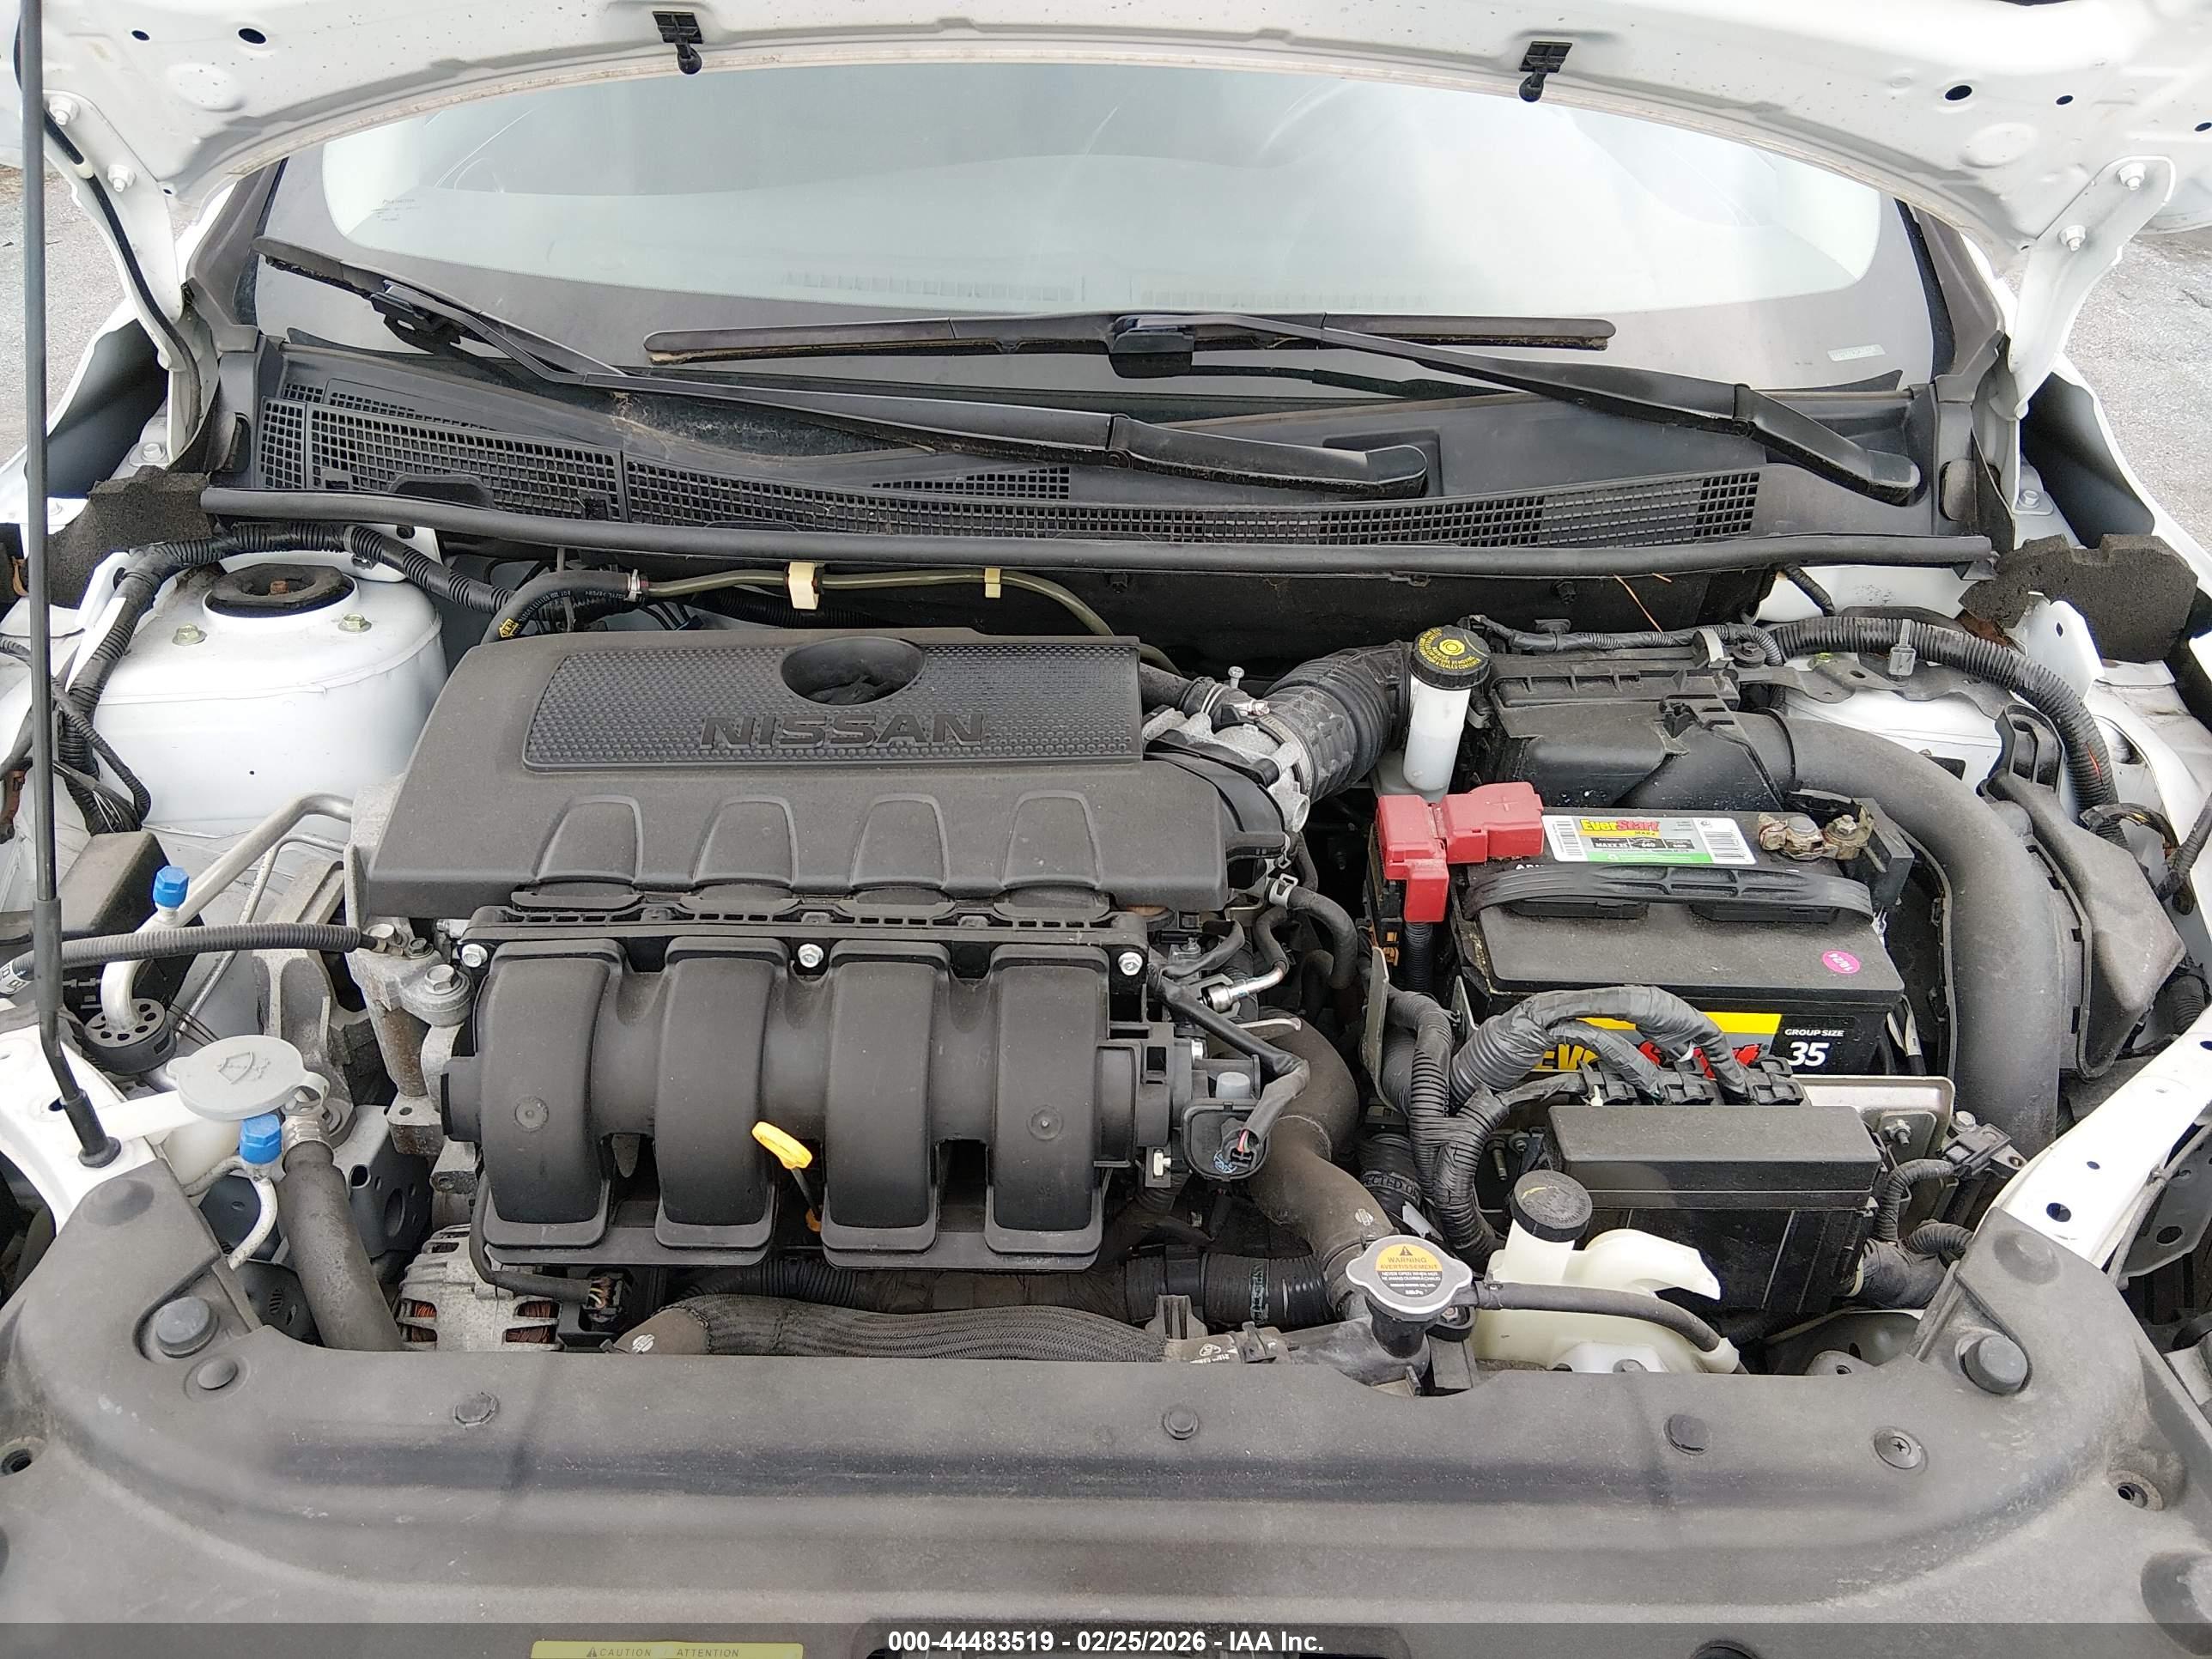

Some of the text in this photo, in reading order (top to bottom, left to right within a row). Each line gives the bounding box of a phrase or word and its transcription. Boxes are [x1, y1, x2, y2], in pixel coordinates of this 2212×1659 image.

[700, 714, 985, 749] NISSAN
[1580, 819, 1660, 831] EverStart
[1789, 1042, 1830, 1066] 35
[600, 1648, 739, 1656] CAUTION ATTENTION
